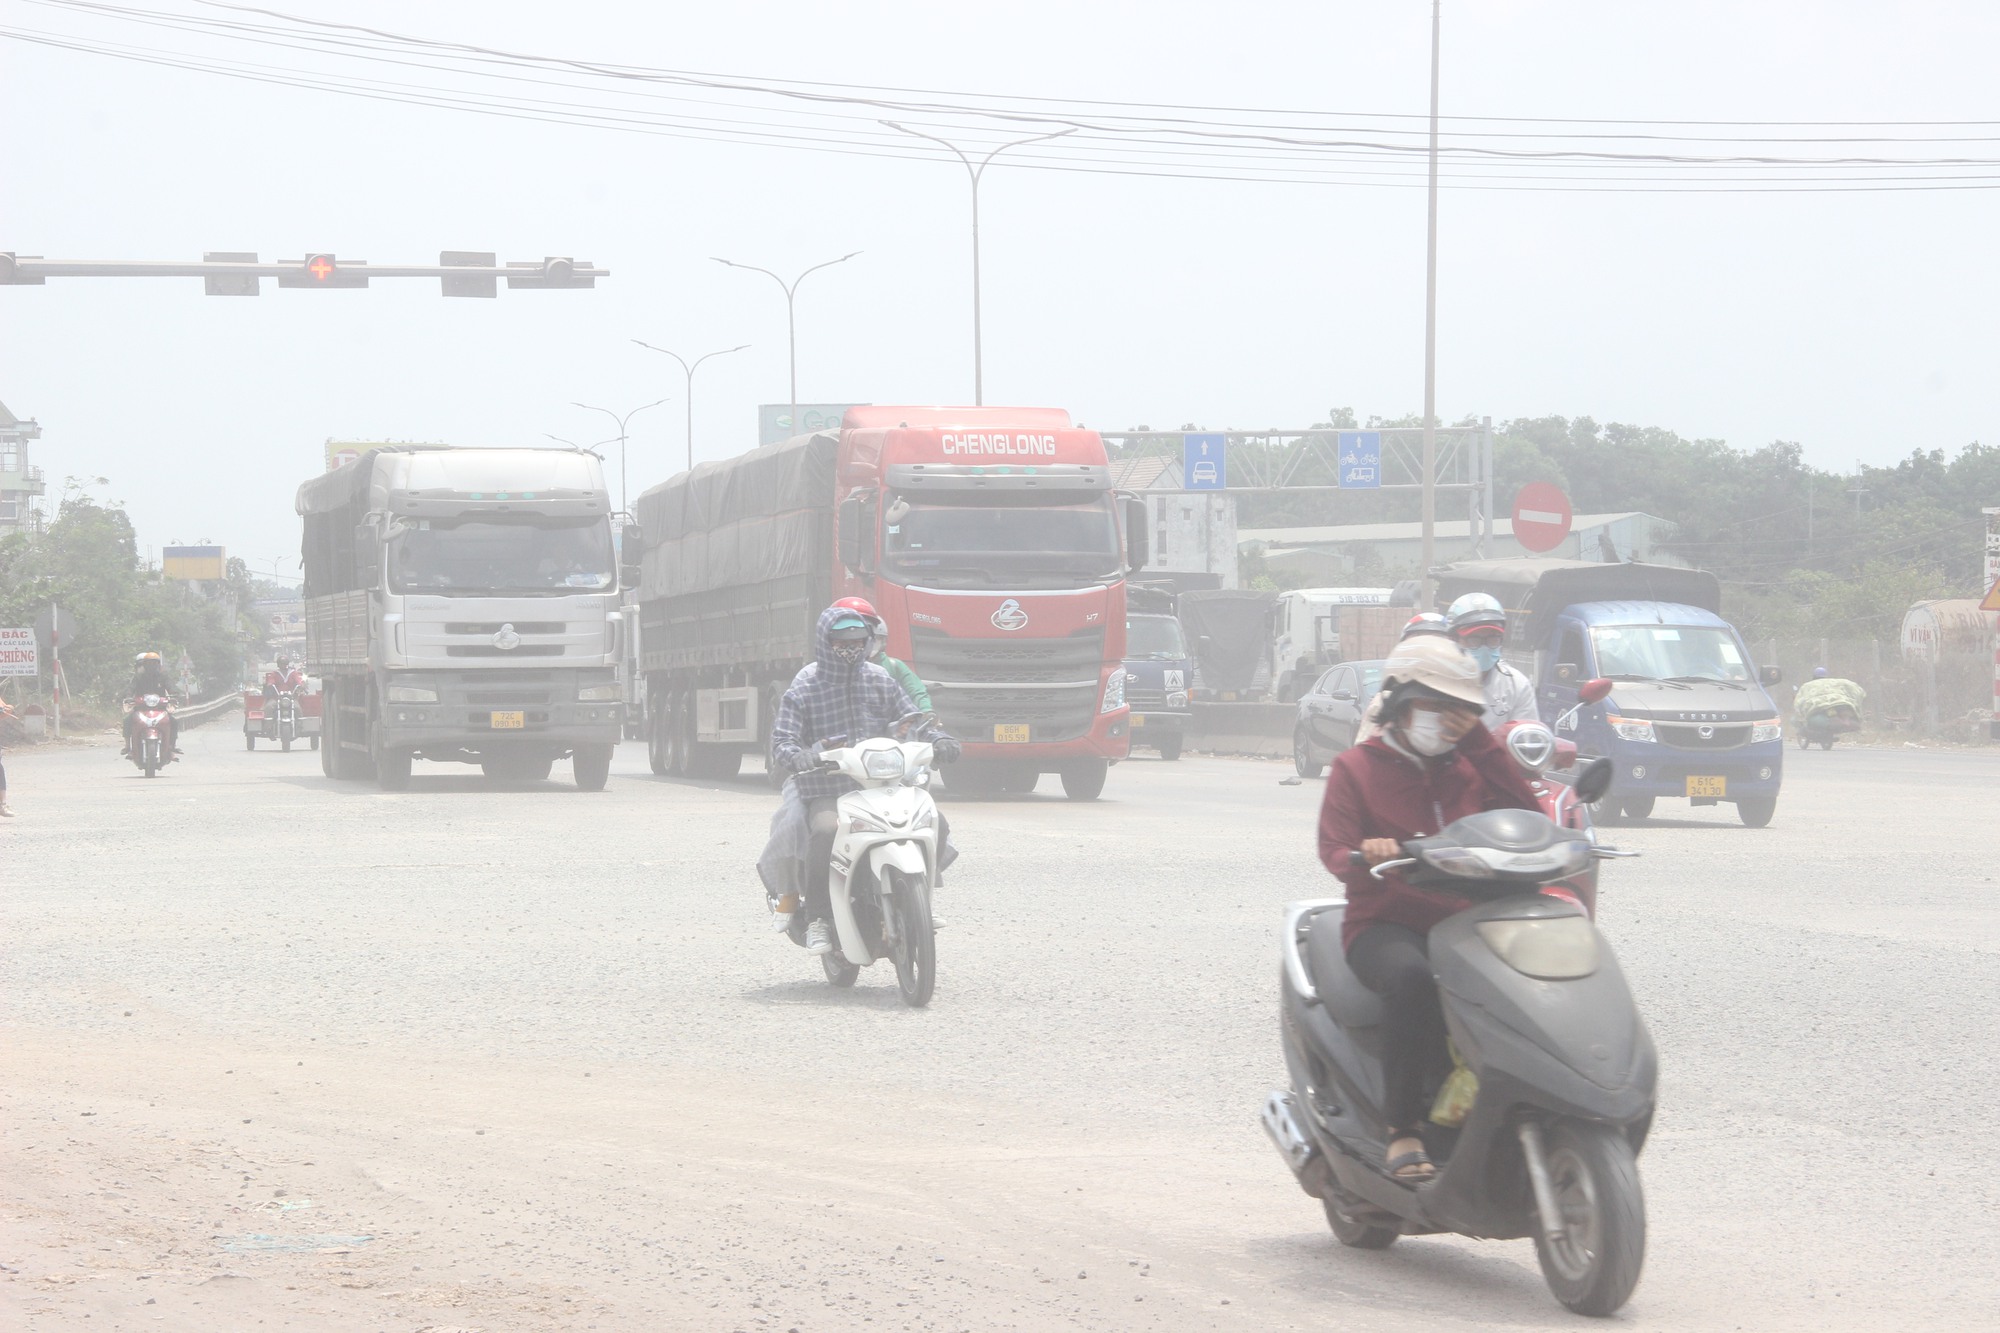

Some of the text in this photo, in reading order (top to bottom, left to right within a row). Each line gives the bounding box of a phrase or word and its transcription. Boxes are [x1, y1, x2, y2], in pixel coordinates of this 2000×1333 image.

[941, 434, 1056, 455] CHENGLONG
[1086, 613, 1099, 623] H7
[500, 712, 515, 720] 72C
[1679, 713, 1728, 721] KENBO
[1697, 777, 1715, 786] 61C
